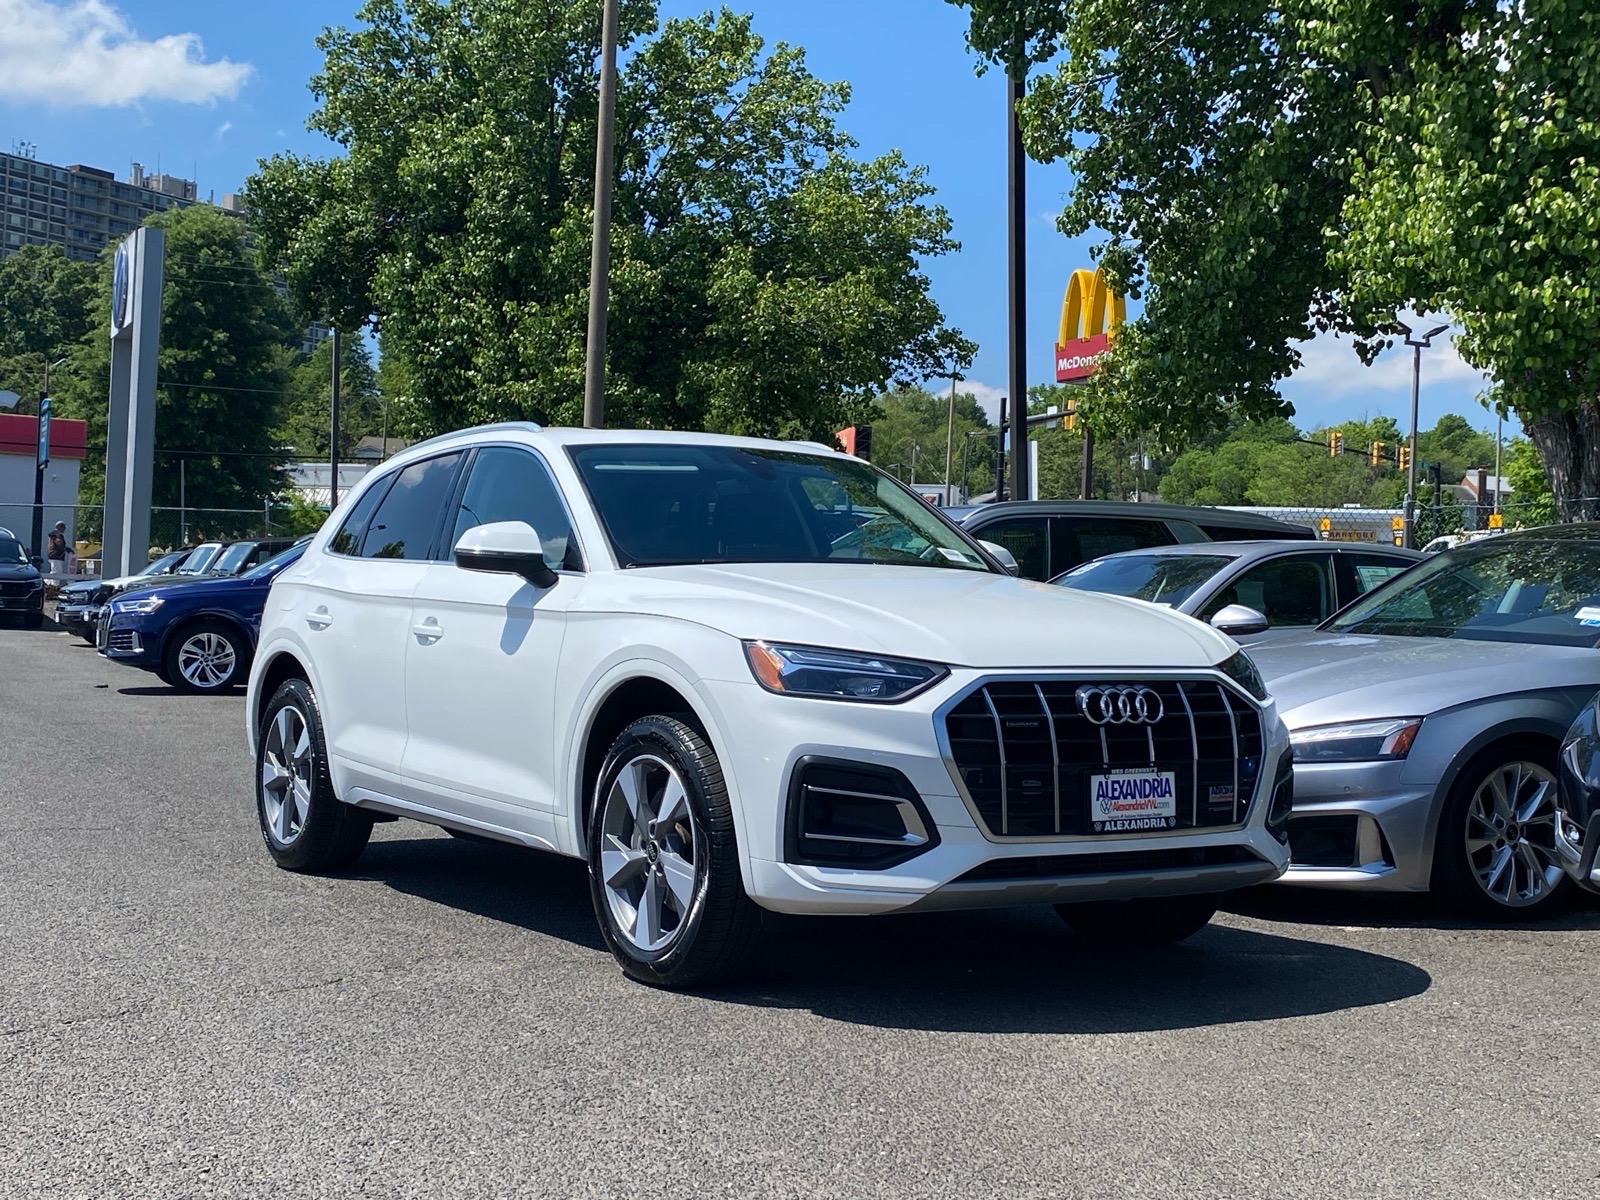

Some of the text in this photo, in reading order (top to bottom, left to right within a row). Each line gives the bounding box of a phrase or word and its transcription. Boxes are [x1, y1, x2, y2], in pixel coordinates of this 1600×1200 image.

[1057, 349, 1113, 371] McDona's
[1096, 777, 1173, 801] ALEXANDRIA
[1104, 817, 1167, 831] ALEXANDRIA
